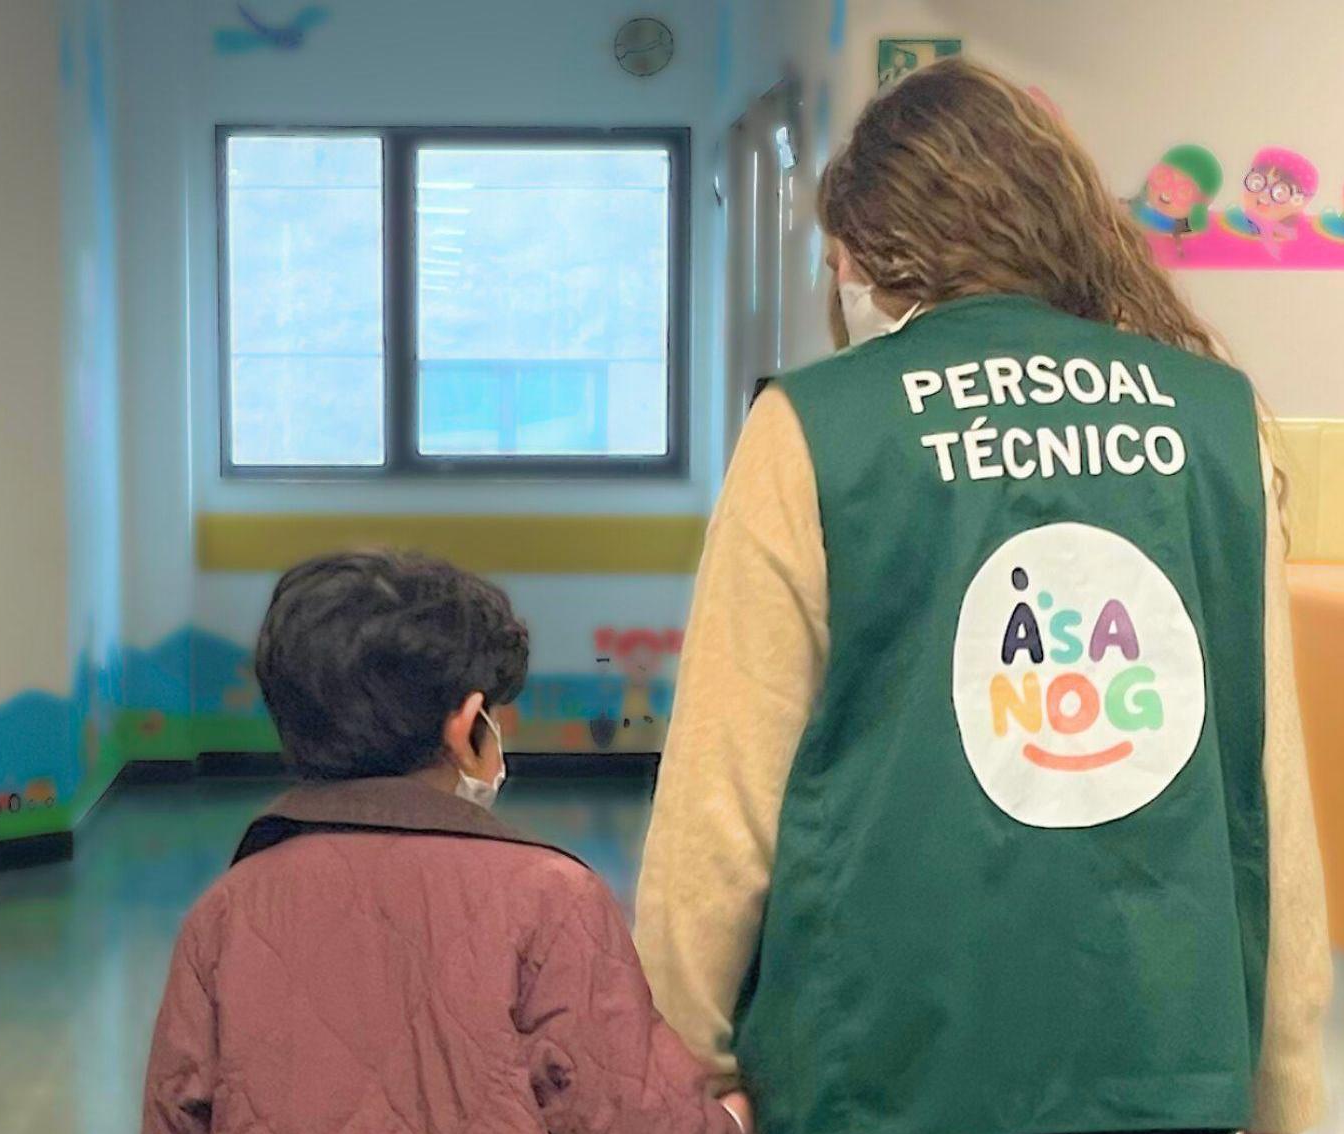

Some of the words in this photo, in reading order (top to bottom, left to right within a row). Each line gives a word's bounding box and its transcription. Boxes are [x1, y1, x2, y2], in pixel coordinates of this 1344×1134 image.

[902, 356, 1176, 414] PERSOAL
[920, 416, 1187, 482] TÉCNICO
[989, 665, 1164, 737] NOG
